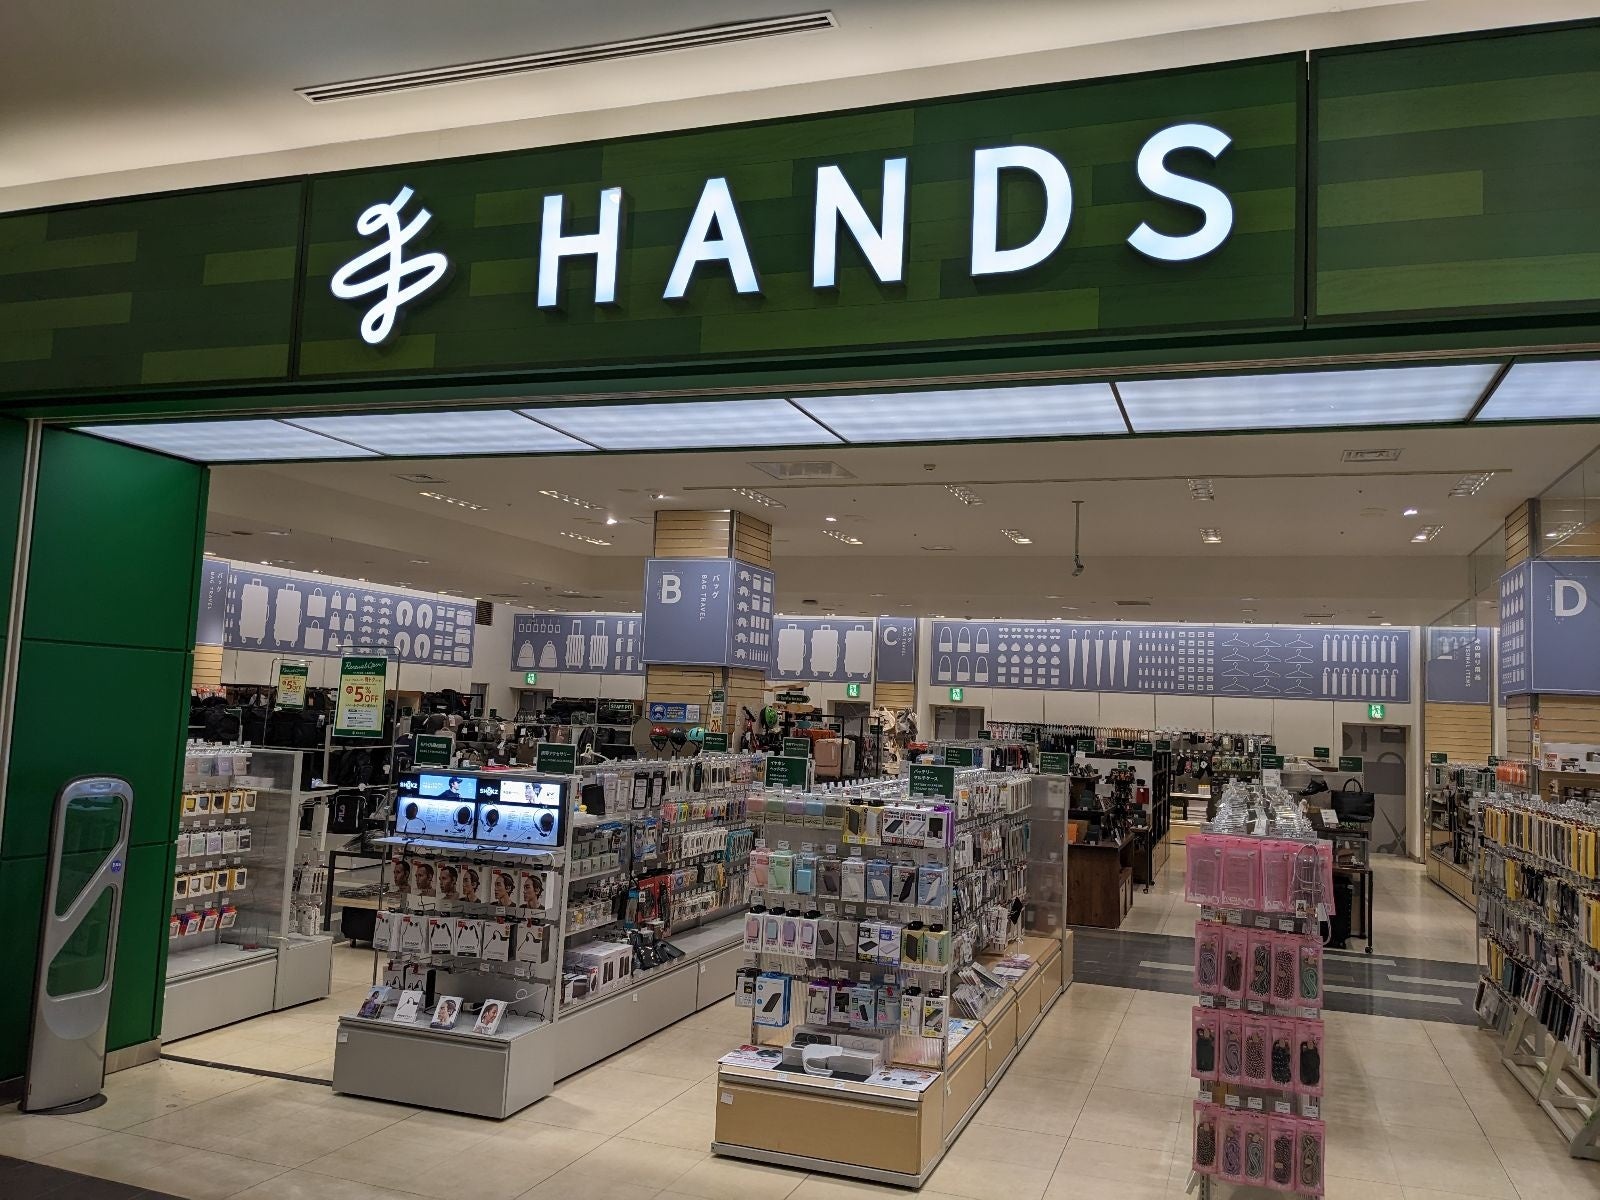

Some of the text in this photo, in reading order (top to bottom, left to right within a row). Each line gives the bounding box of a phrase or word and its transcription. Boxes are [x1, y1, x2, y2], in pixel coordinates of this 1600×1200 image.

[538, 124, 1232, 306] HANDS
[662, 574, 681, 603] B
[712, 574, 720, 599] バッグ
[1555, 580, 1587, 617] D
[883, 626, 898, 646] C
[364, 694, 379, 703] OFF
